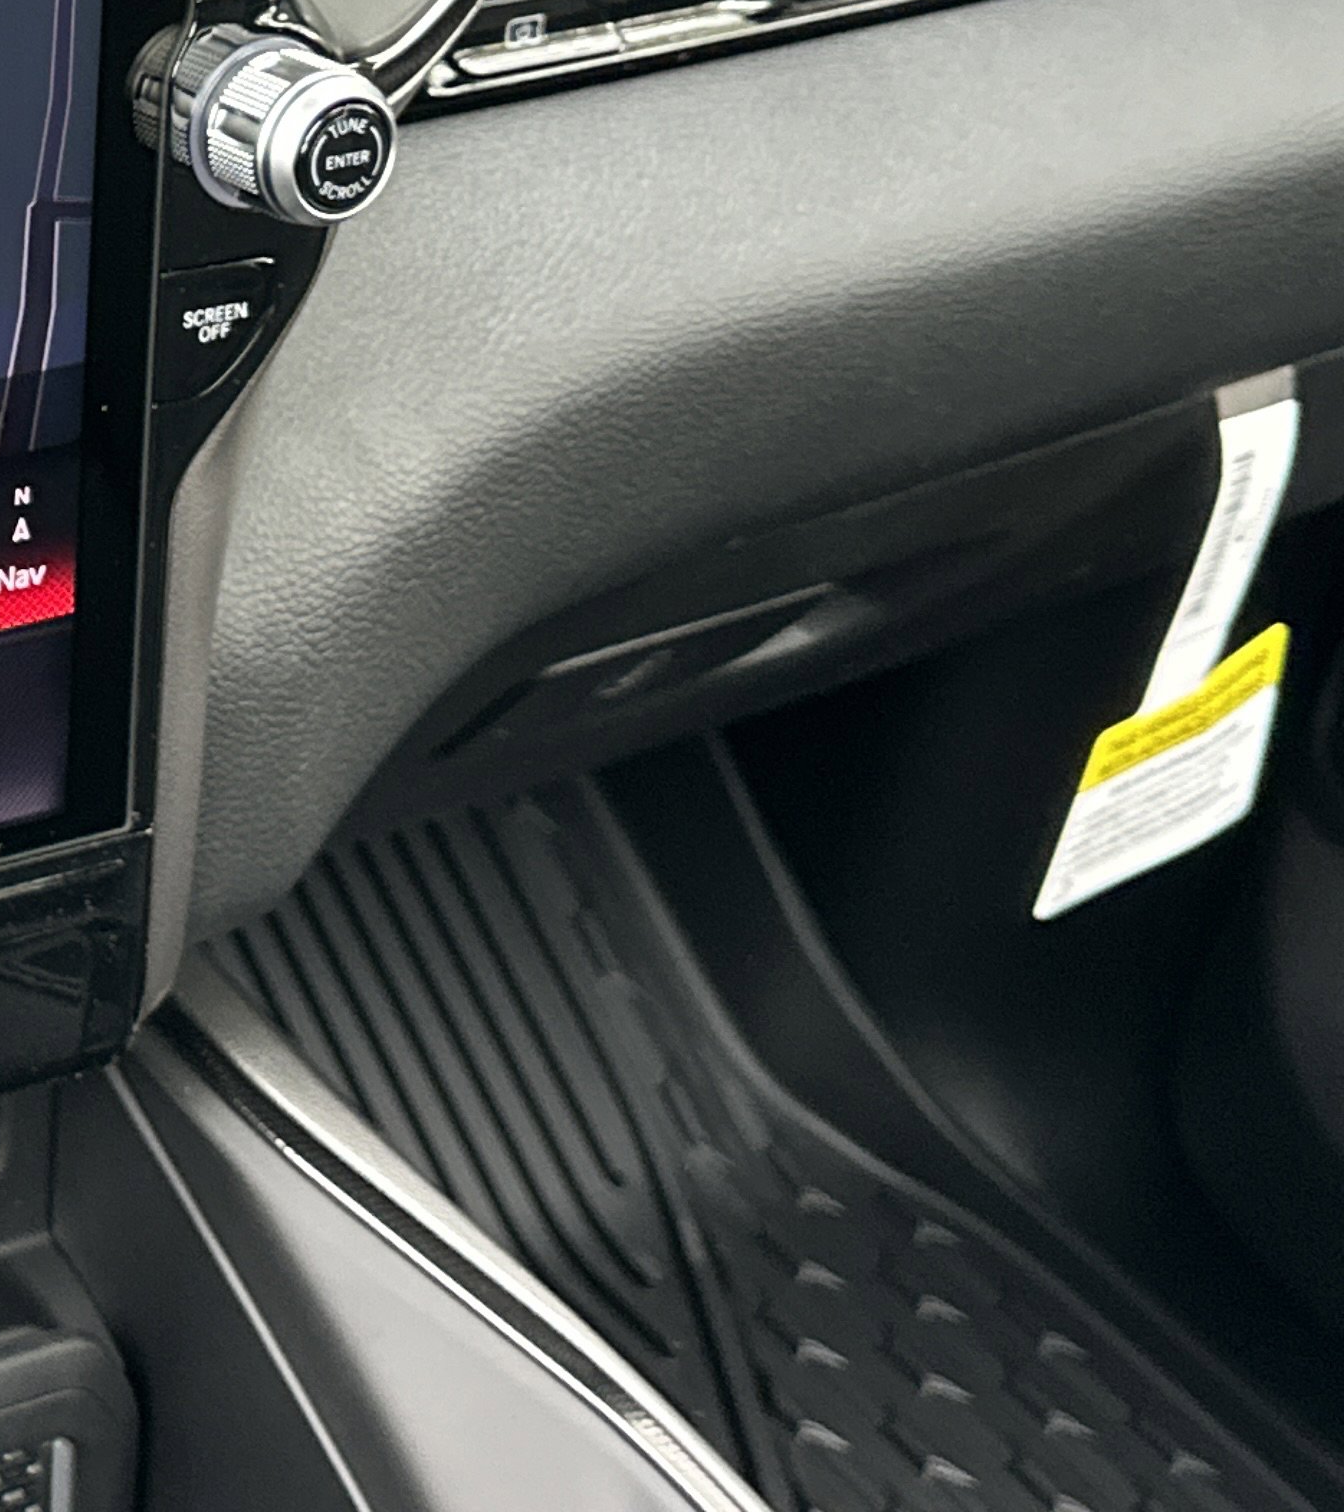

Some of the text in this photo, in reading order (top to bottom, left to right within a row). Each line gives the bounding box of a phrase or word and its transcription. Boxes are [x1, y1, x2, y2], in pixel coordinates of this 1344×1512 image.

[328, 118, 369, 138] TUNE
[325, 149, 370, 170] ENTER
[183, 301, 249, 329] SCREEN
[199, 323, 231, 343] OFF
[14, 486, 31, 506] N
